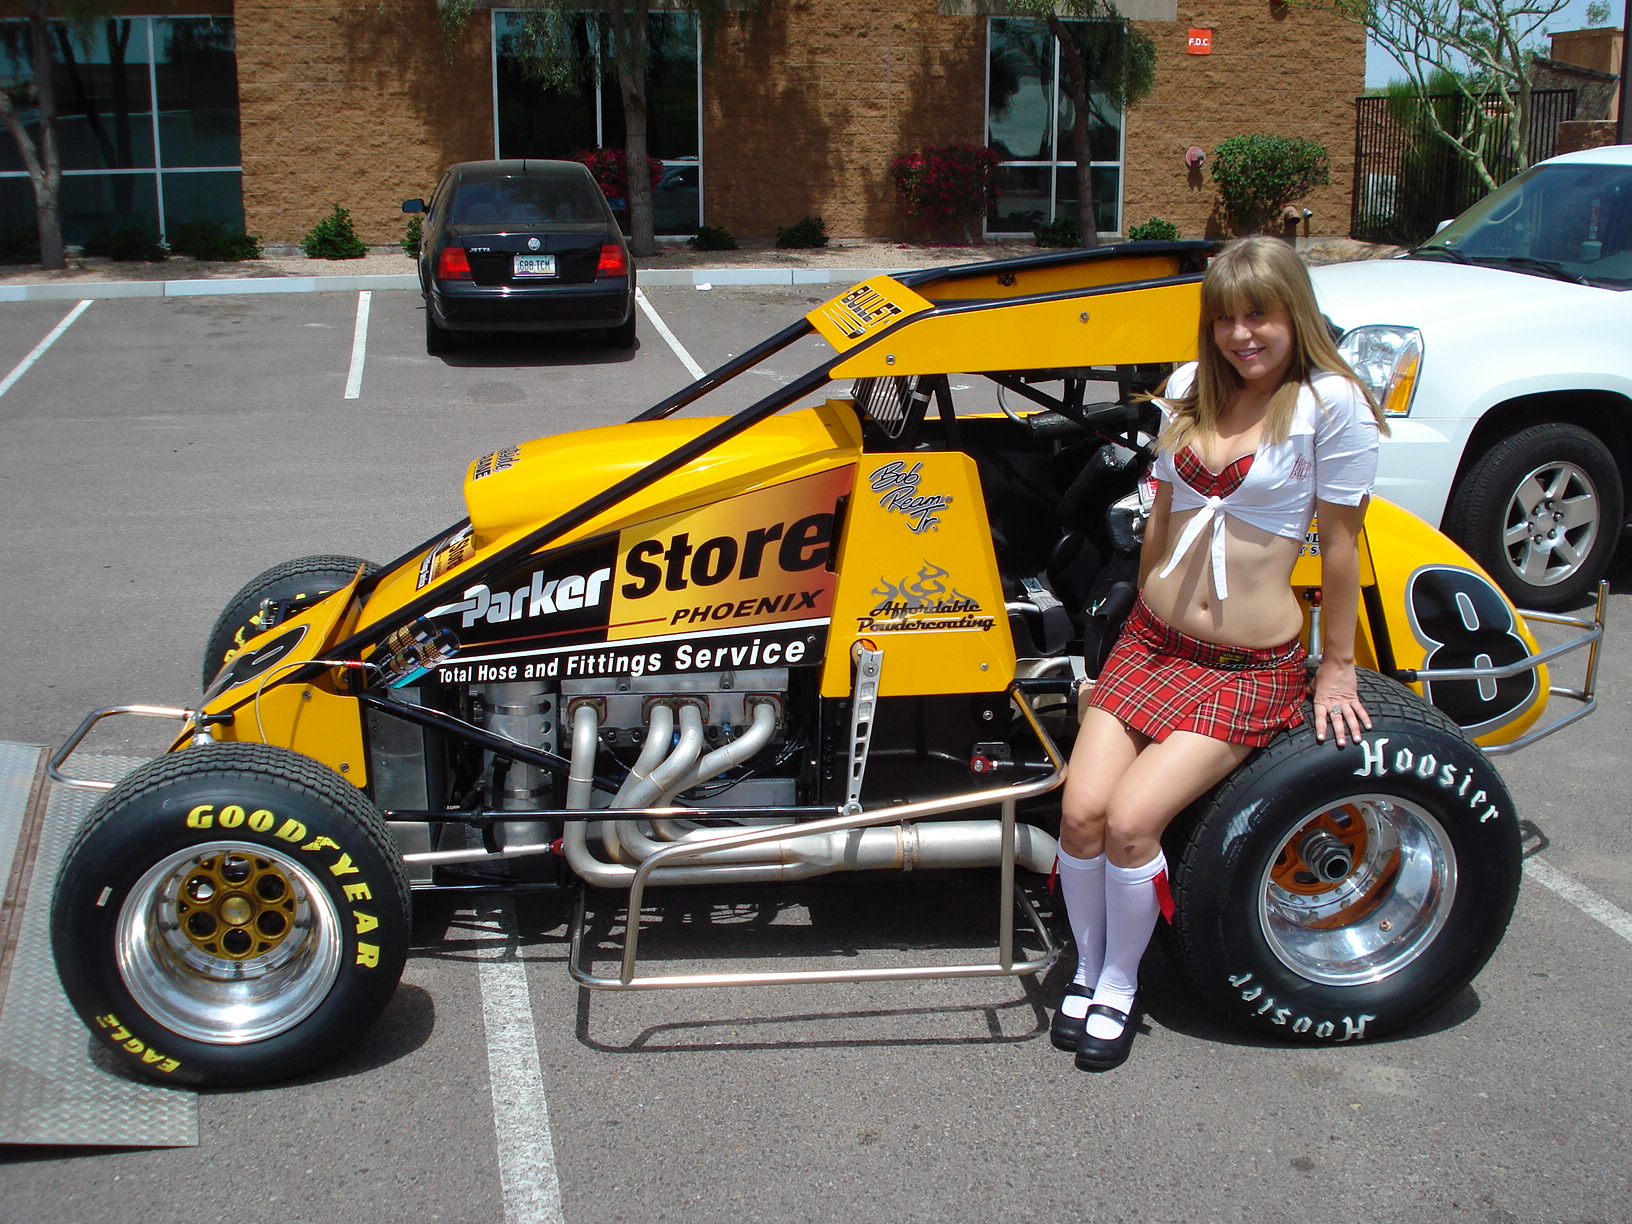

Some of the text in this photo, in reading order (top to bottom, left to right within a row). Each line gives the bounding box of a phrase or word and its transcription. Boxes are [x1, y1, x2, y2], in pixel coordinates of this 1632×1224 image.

[1188, 37, 1210, 46] F.D.C.
[839, 284, 904, 327] BULLET
[868, 460, 923, 491] Bob
[878, 485, 945, 513] Ream
[905, 503, 946, 535] Jr.
[461, 567, 611, 629] Parker
[621, 512, 834, 600] Store
[670, 588, 825, 626] PHOENIX
[856, 613, 996, 632] Powdercoating
[869, 599, 983, 618] Affordable
[438, 638, 806, 684] Total Hose and Fittings Service
[1404, 563, 1541, 739] 8
[1353, 737, 1499, 823] Hoosier
[186, 804, 380, 968] GOODYEAR
[1228, 973, 1376, 1042] Hoosier
[95, 1013, 181, 1073] EAGLE
